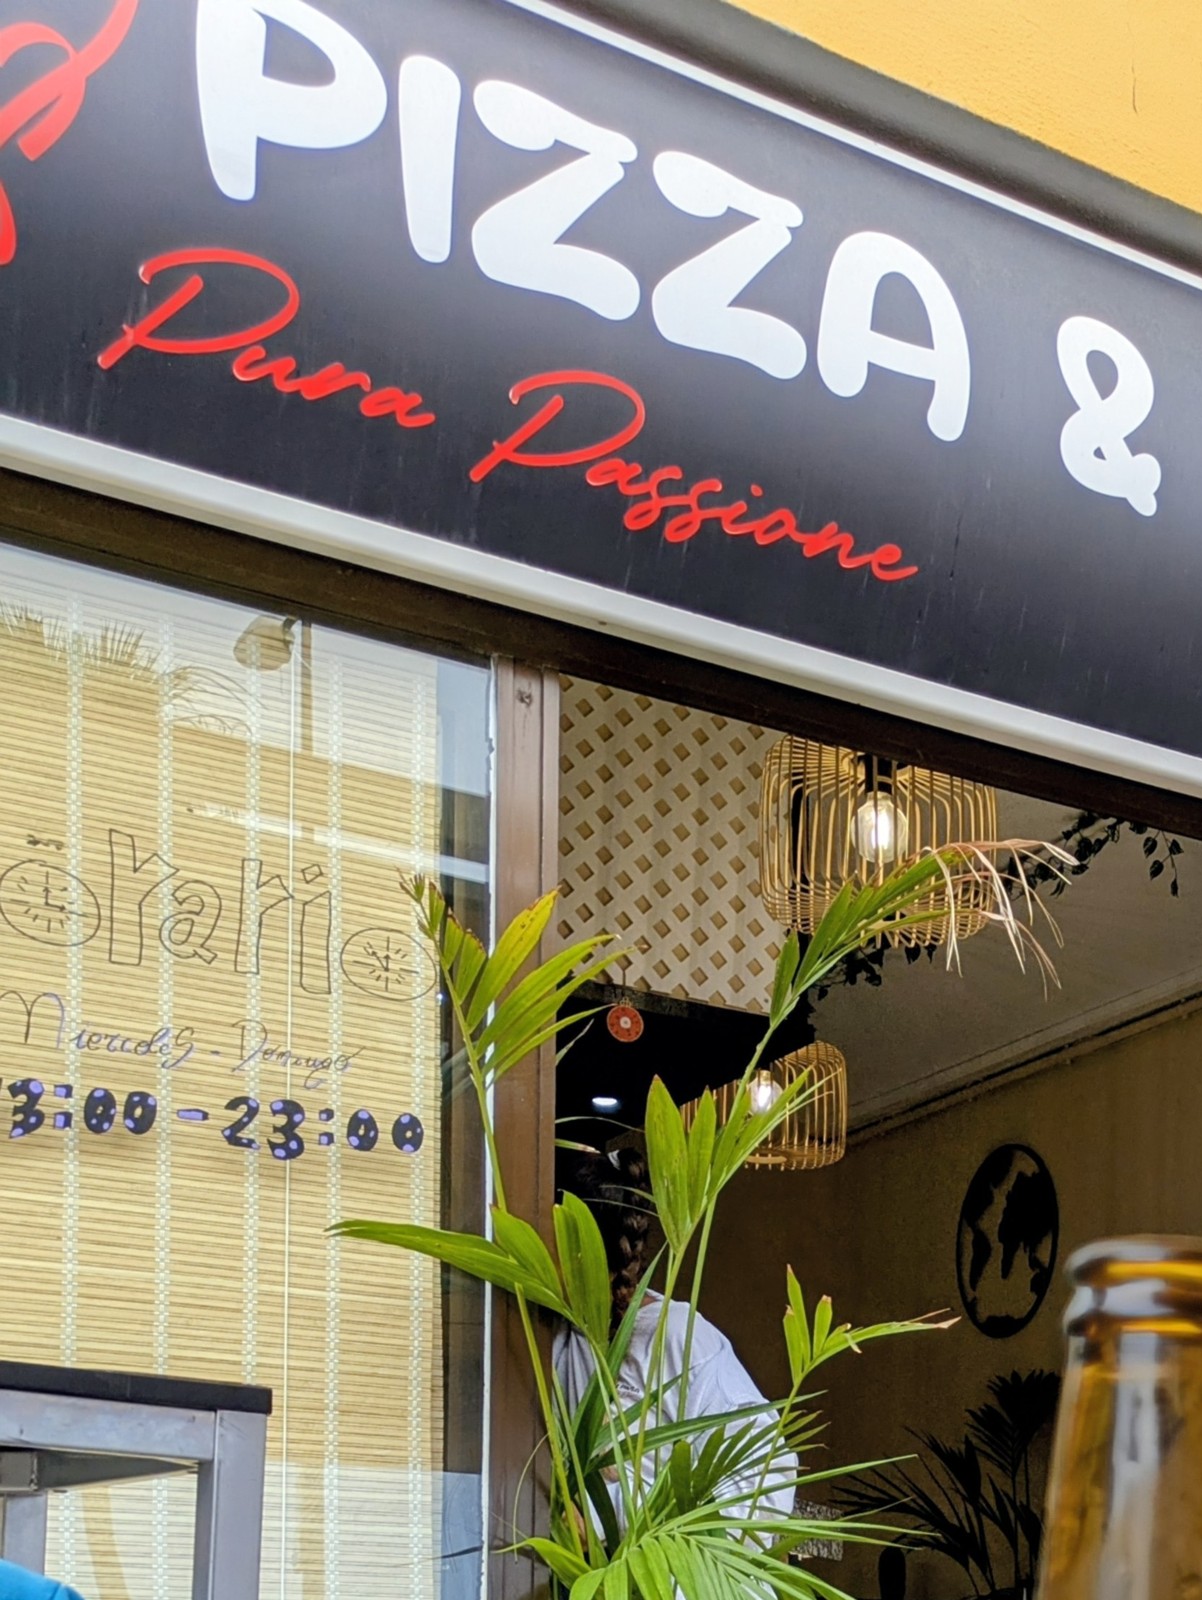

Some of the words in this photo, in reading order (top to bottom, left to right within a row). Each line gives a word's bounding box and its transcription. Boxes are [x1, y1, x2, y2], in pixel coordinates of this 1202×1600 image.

[97, 247, 436, 430] Pura
[469, 370, 919, 582] Passione
[196, 0, 971, 442] PIZZA
[1057, 316, 1162, 516] &
[0, 1077, 158, 1140] 3:00
[221, 1095, 425, 1161] 23:00
